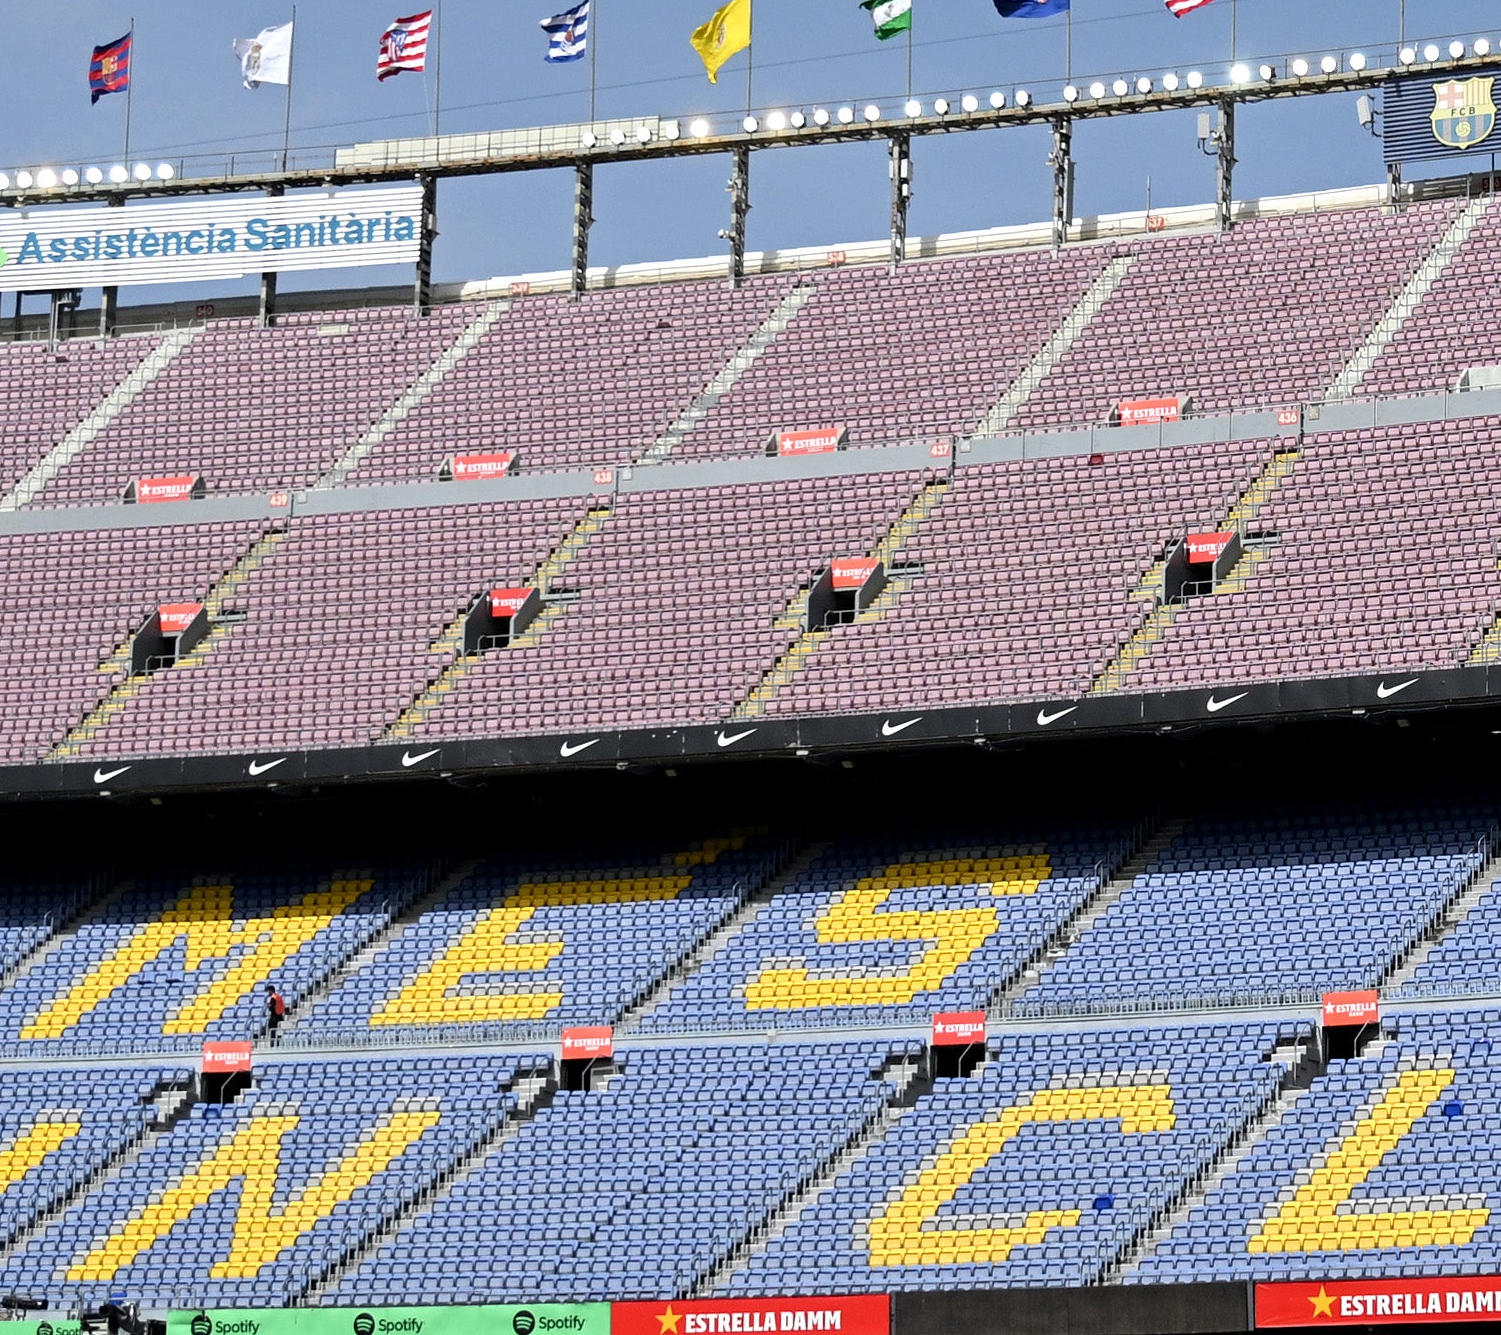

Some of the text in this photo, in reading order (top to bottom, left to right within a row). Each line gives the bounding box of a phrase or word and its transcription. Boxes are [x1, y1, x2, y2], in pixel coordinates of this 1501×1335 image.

[17, 211, 414, 266] Assistència Sanitària
[1133, 406, 1178, 417] ESTRELLA
[1279, 412, 1296, 423] 436
[794, 436, 838, 449] ESTRELLA
[931, 445, 949, 455] 437
[467, 461, 509, 472] ESTRELLA
[594, 471, 612, 483] 438
[151, 483, 193, 494] ESTRELLA
[270, 495, 287, 506] 439
[1336, 1002, 1377, 1013] ESTRELLA
[945, 1023, 984, 1032] ESTRELLA
[573, 1037, 611, 1047] ESTRELLA
[214, 1052, 250, 1061] ESTRELLA
[1340, 1292, 1442, 1316] ESTRELLA
[216, 1320, 259, 1335] Spotify
[379, 1318, 422, 1333] Spotify
[539, 1316, 584, 1330] Spotify
[685, 1310, 842, 1334] ESTRELLA DAMM
